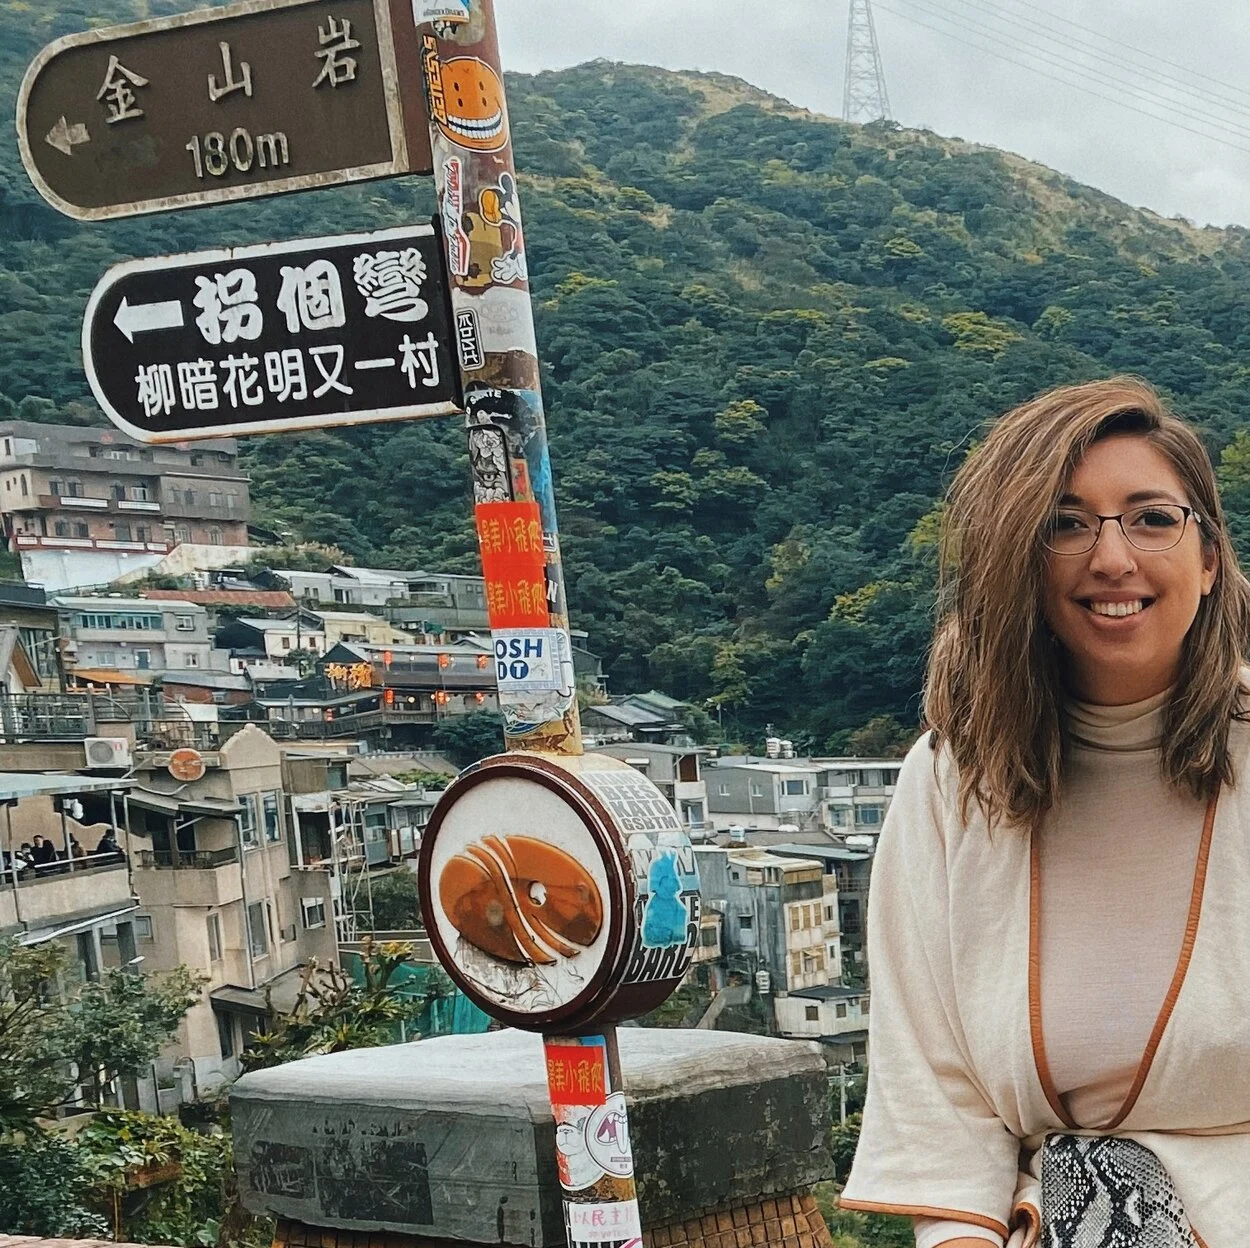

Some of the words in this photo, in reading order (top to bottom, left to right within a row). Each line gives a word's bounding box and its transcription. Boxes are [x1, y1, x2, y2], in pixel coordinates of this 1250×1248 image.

[96, 15, 361, 125] 金山岩
[185, 127, 290, 178] 180m
[192, 247, 429, 346] 拐個彎
[134, 333, 440, 418] 柳暗花明又一村
[599, 784, 659, 800] BEES
[609, 799, 671, 818] KATO
